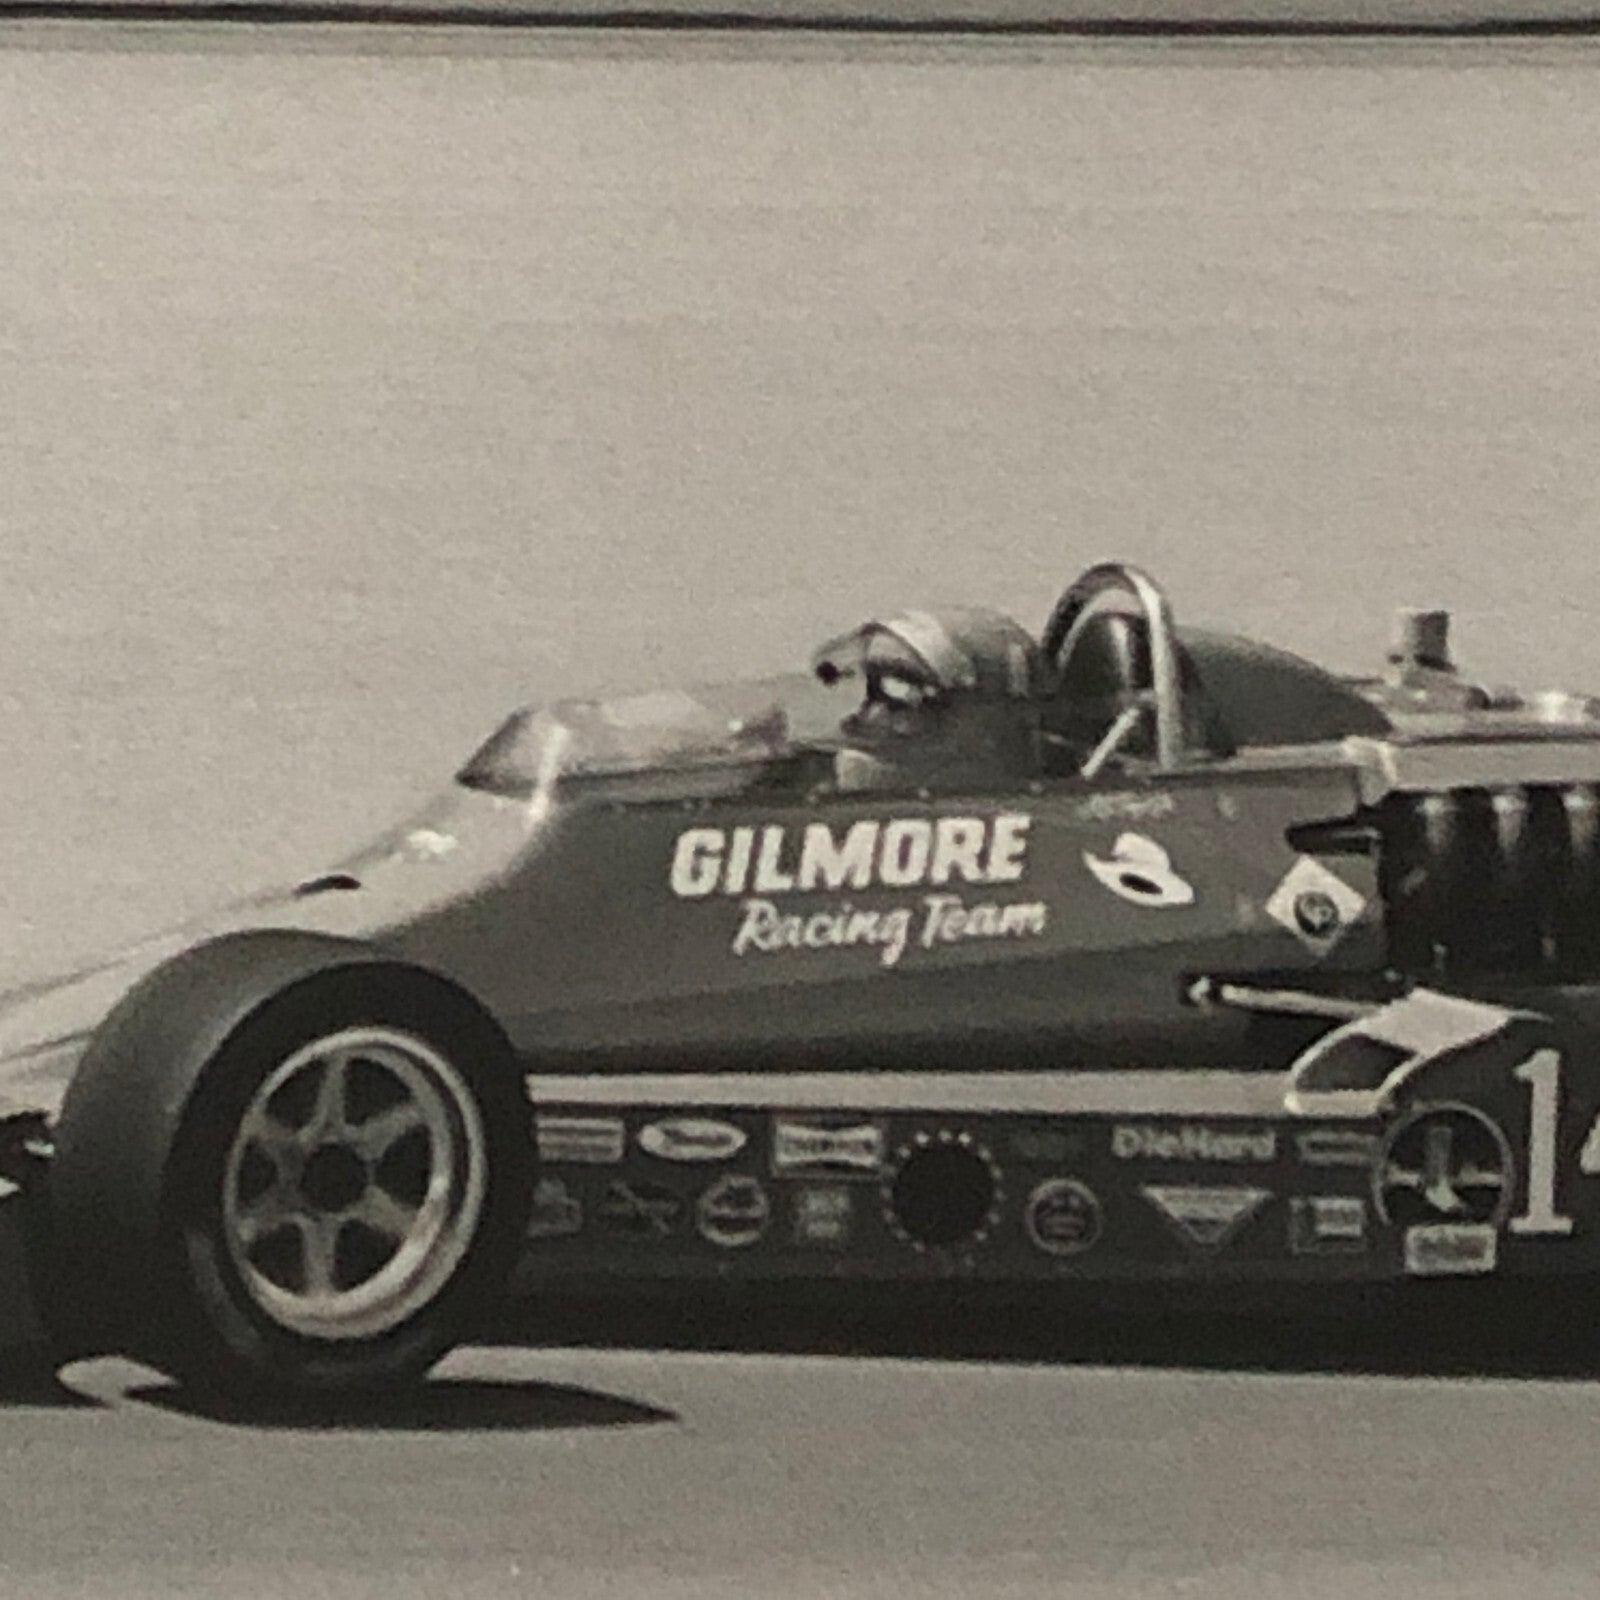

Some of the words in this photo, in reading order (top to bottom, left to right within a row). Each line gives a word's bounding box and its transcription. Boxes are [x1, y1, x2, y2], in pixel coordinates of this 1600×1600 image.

[670, 814, 1031, 897] GILMORE
[733, 900, 911, 966] Racing
[922, 894, 1047, 949] Team
